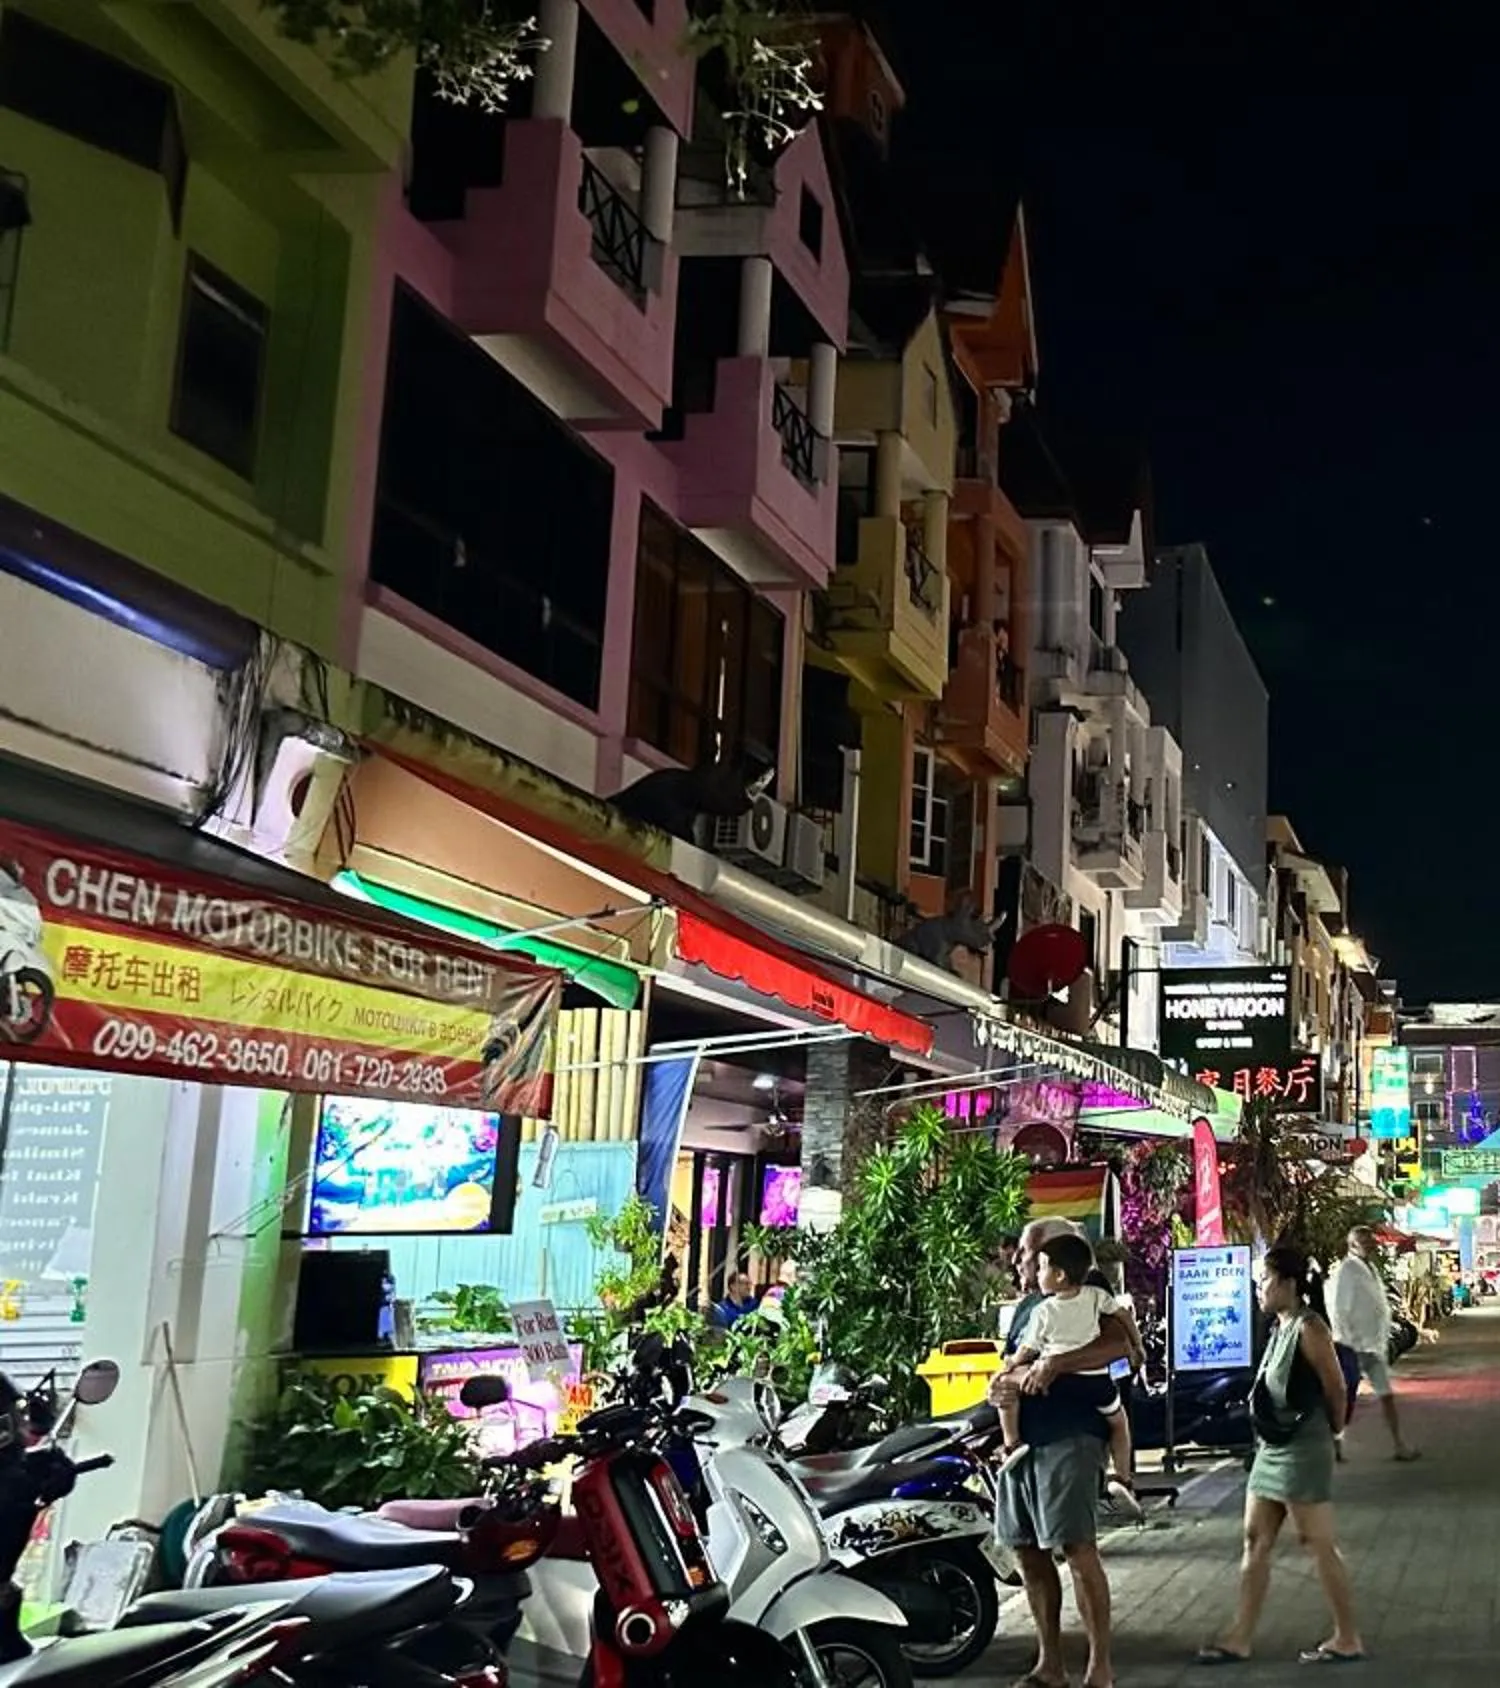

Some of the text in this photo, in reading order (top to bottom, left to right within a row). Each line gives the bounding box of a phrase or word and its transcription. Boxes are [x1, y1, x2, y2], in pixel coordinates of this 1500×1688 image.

[47, 858, 497, 999] CHEN MOTORBIKE FOR RENT
[62, 944, 201, 1003] 摩托车出租
[1165, 997, 1285, 1018] HONEYMOON
